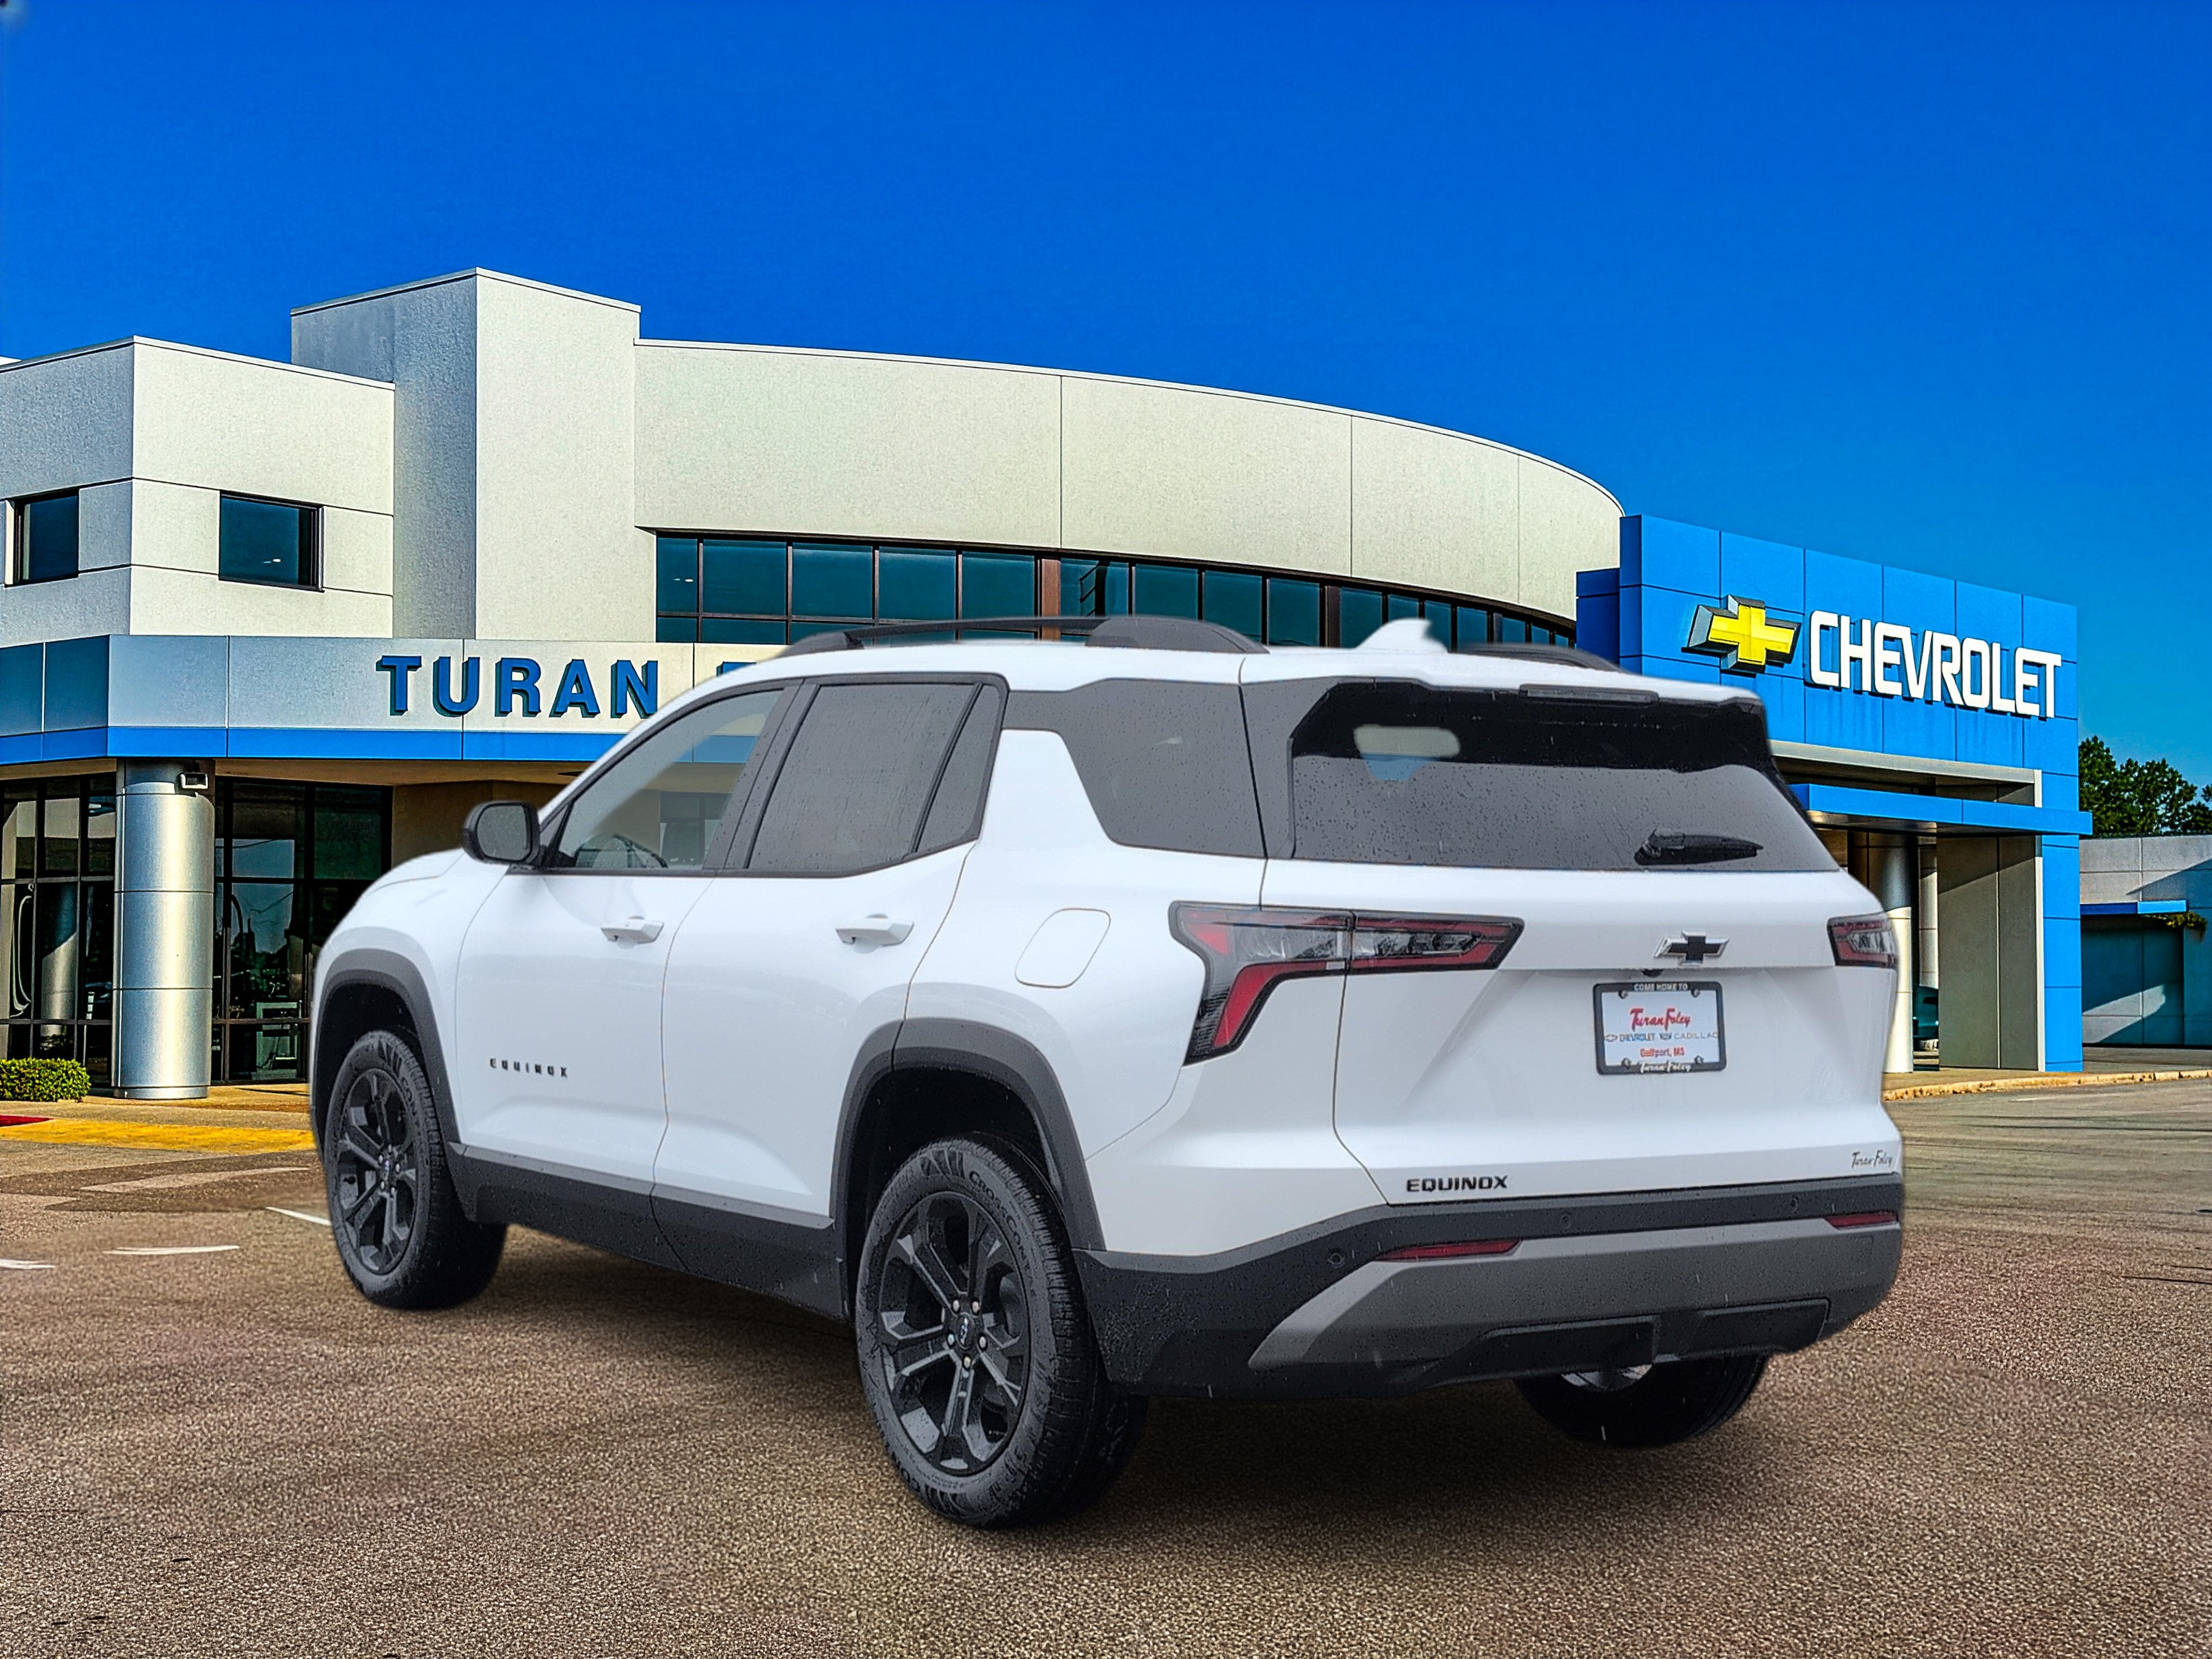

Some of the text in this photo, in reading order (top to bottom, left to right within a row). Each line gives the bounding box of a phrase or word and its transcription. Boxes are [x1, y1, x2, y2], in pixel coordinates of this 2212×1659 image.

[1810, 610, 2062, 718] CHEVROLET
[376, 655, 659, 719] TURAN
[1674, 1032, 1718, 1040] CADILLAC
[490, 1058, 567, 1078] EQUINOX
[1406, 1175, 1508, 1193] EQUINOX
